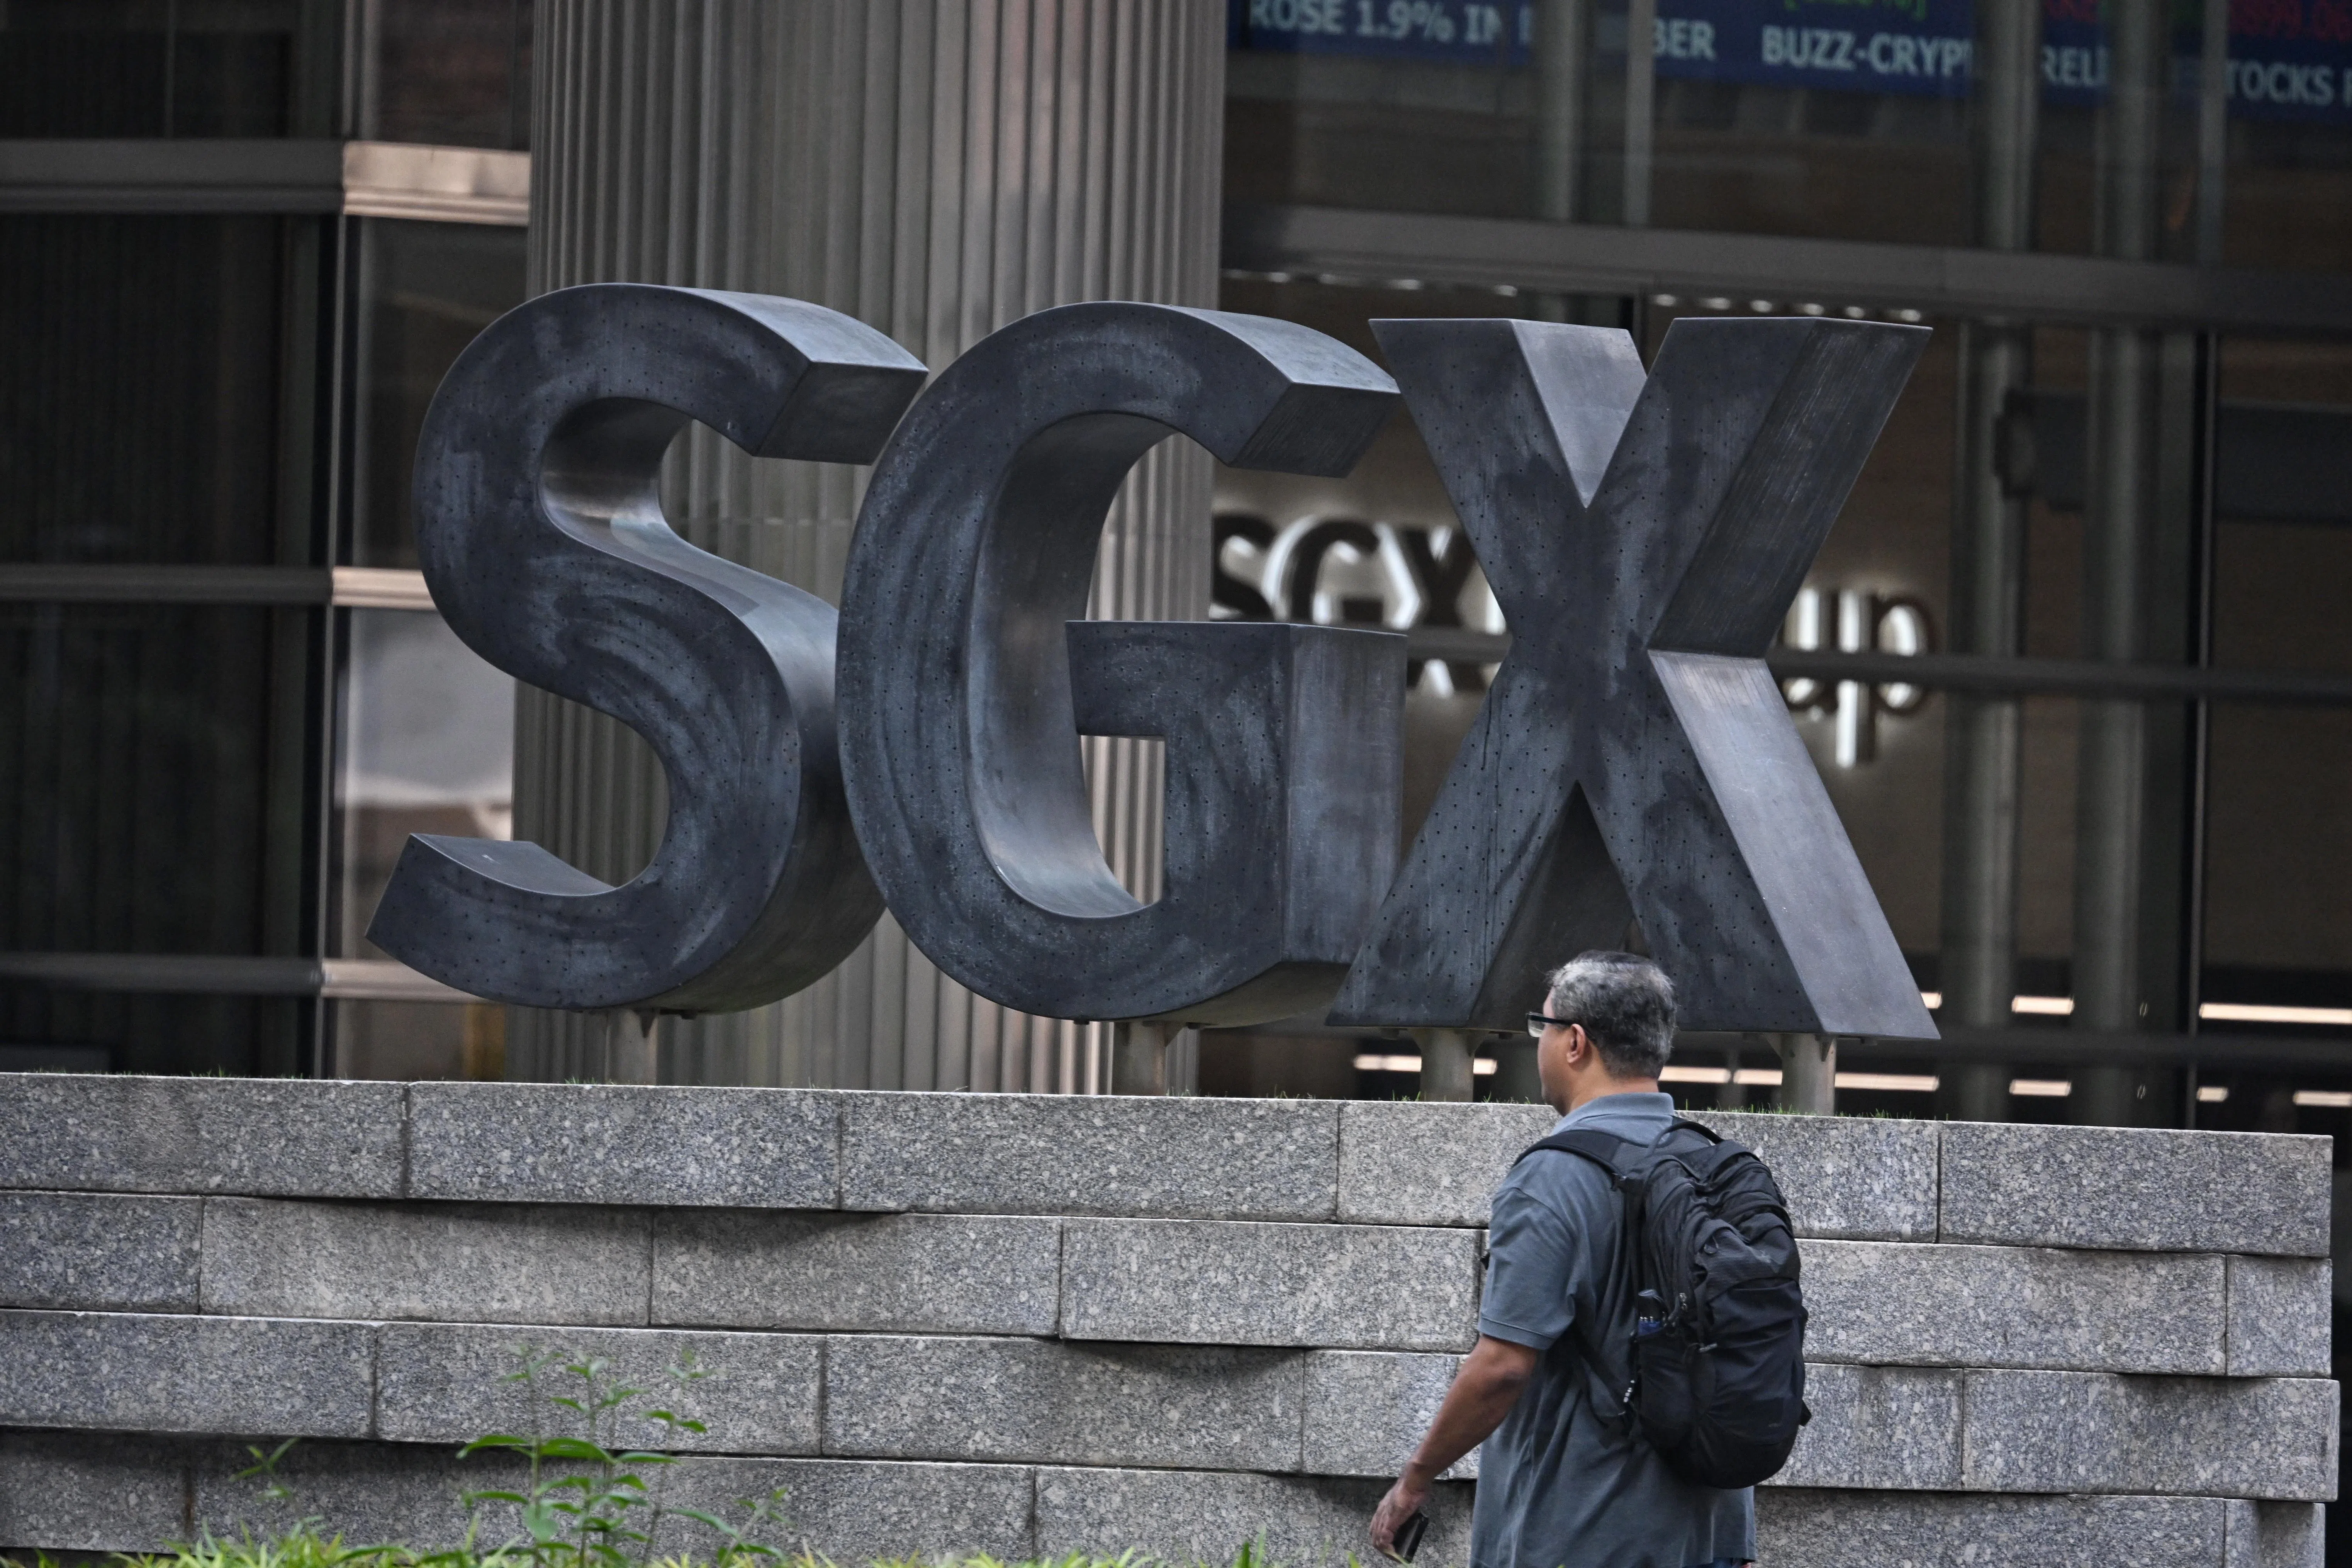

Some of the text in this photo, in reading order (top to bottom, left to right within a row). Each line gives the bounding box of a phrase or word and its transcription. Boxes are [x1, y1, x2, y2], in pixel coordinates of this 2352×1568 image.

[1355, 0, 1455, 43] 1.9%
[1761, 24, 1972, 76] BUZZ-CRYP
[2224, 59, 2335, 107] TOCKS
[367, 282, 1941, 1040] SGX
